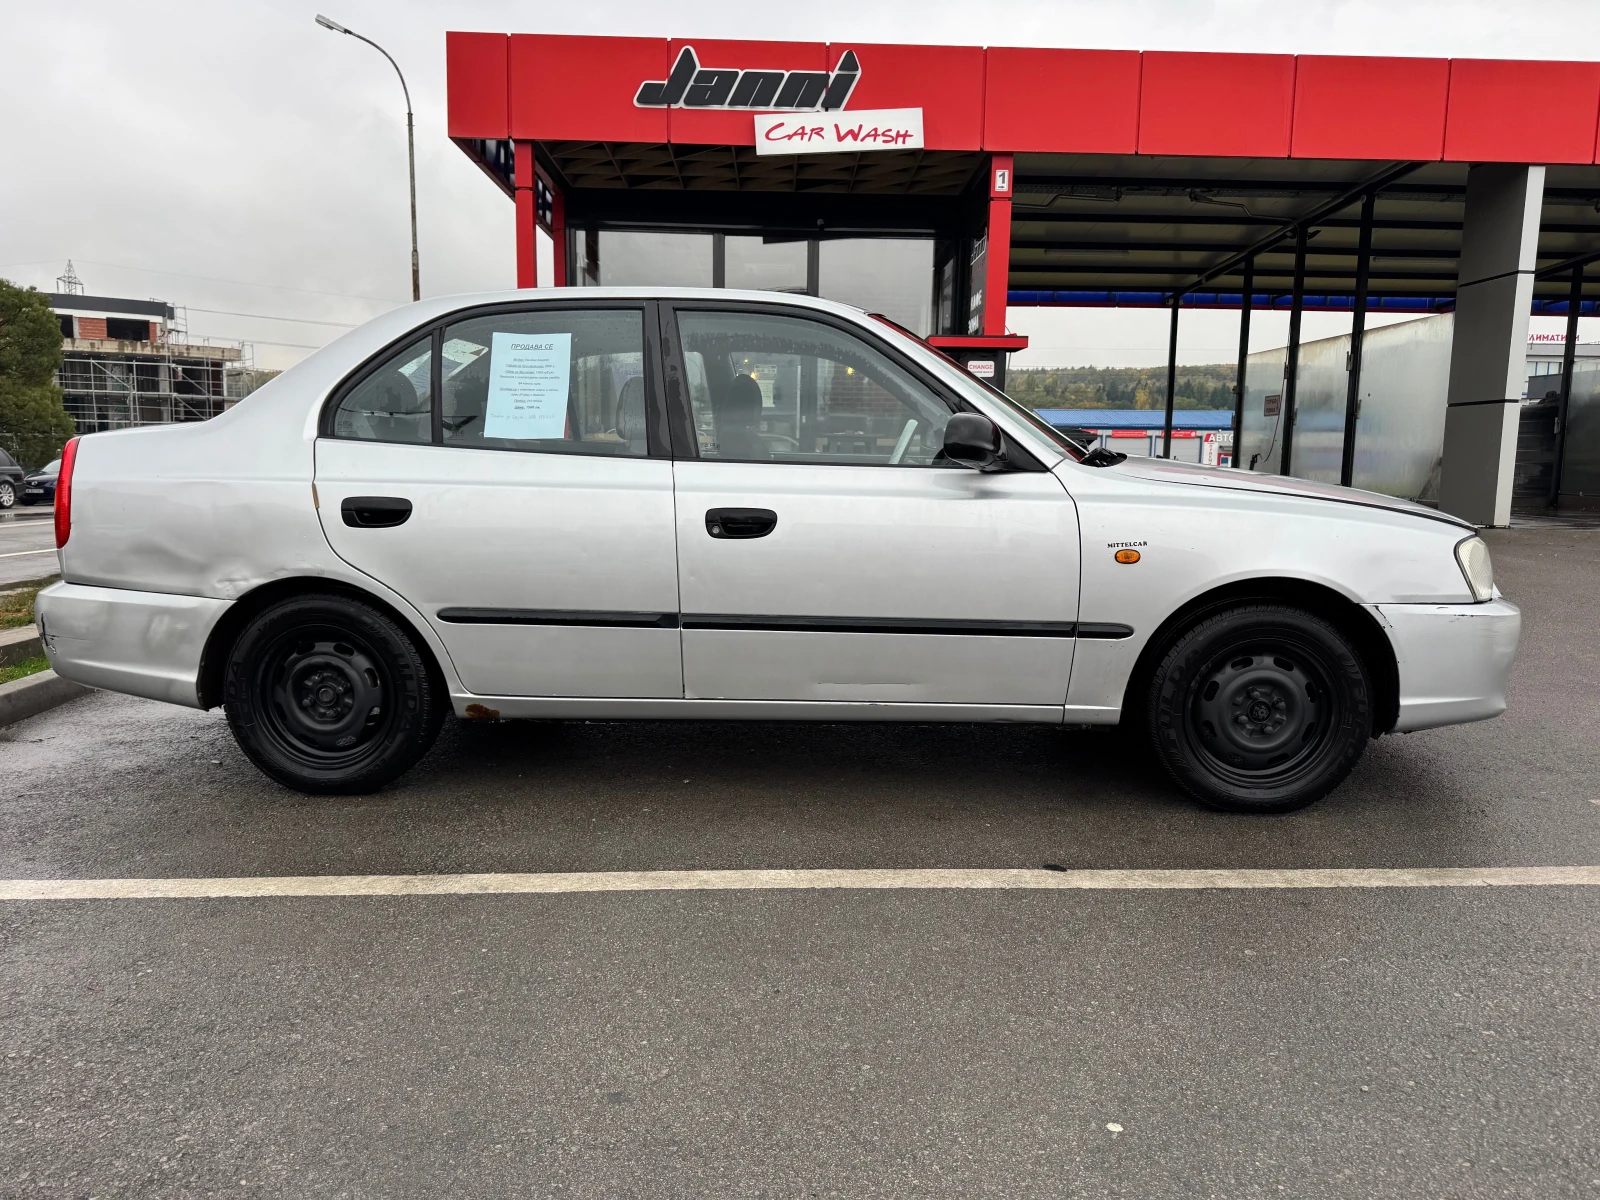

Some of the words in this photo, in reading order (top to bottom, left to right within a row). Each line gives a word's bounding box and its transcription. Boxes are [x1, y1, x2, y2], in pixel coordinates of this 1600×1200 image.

[634, 46, 861, 110] Janni
[764, 121, 825, 143] CAR
[834, 122, 914, 145] WASH
[998, 171, 1006, 185] 1
[510, 343, 543, 351] ПРОДАВА
[544, 343, 554, 351] СЕ
